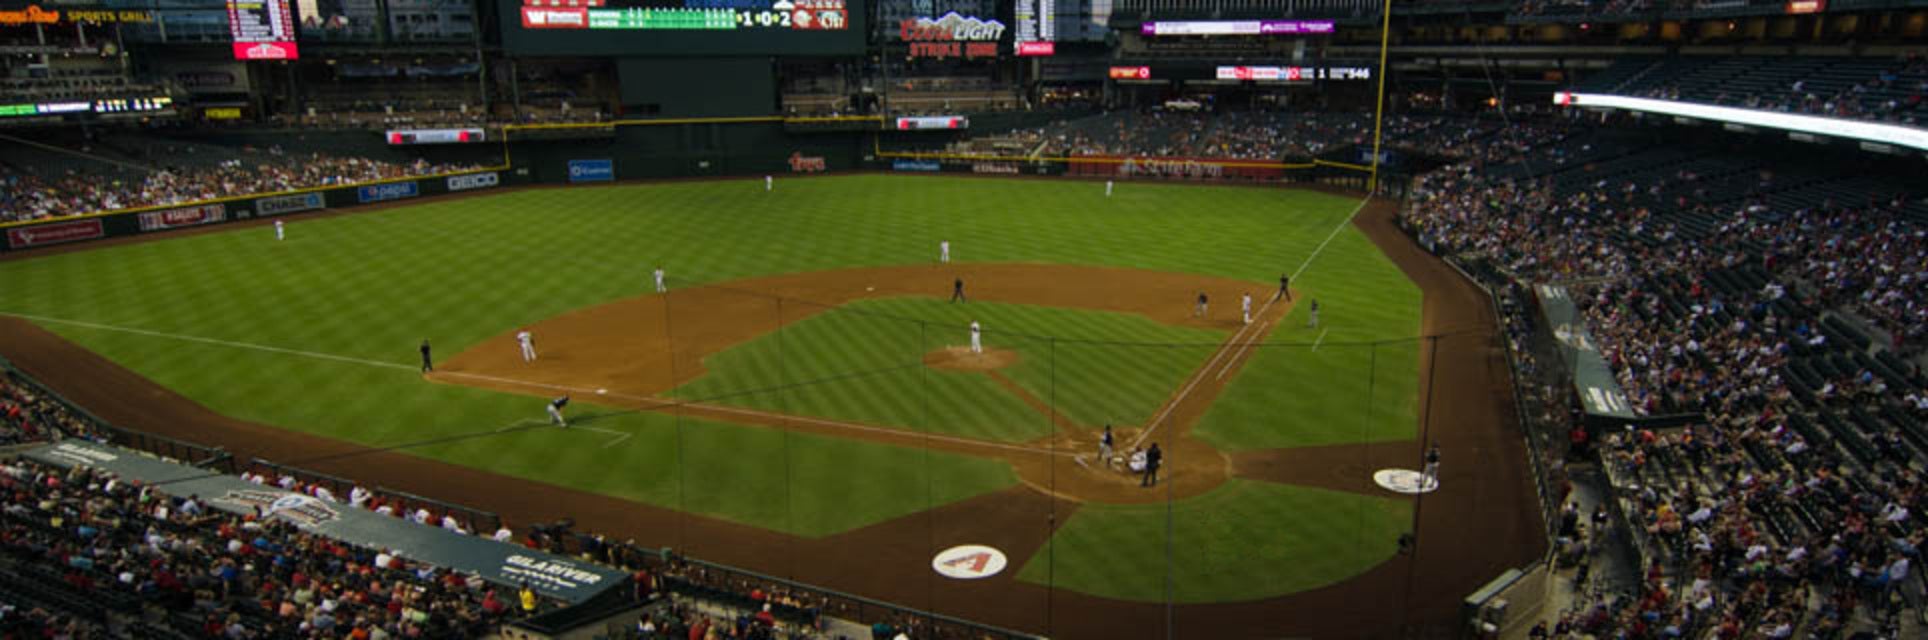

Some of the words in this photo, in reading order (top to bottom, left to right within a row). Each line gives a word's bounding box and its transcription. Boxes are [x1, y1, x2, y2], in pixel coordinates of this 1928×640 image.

[67, 11, 117, 21] SPORTS
[119, 11, 153, 21] GRILL
[743, 11, 753, 26] 1
[761, 11, 772, 26] 0
[780, 11, 791, 26] 2
[953, 24, 1006, 41] LIGHT
[448, 172, 499, 190] GEICO
